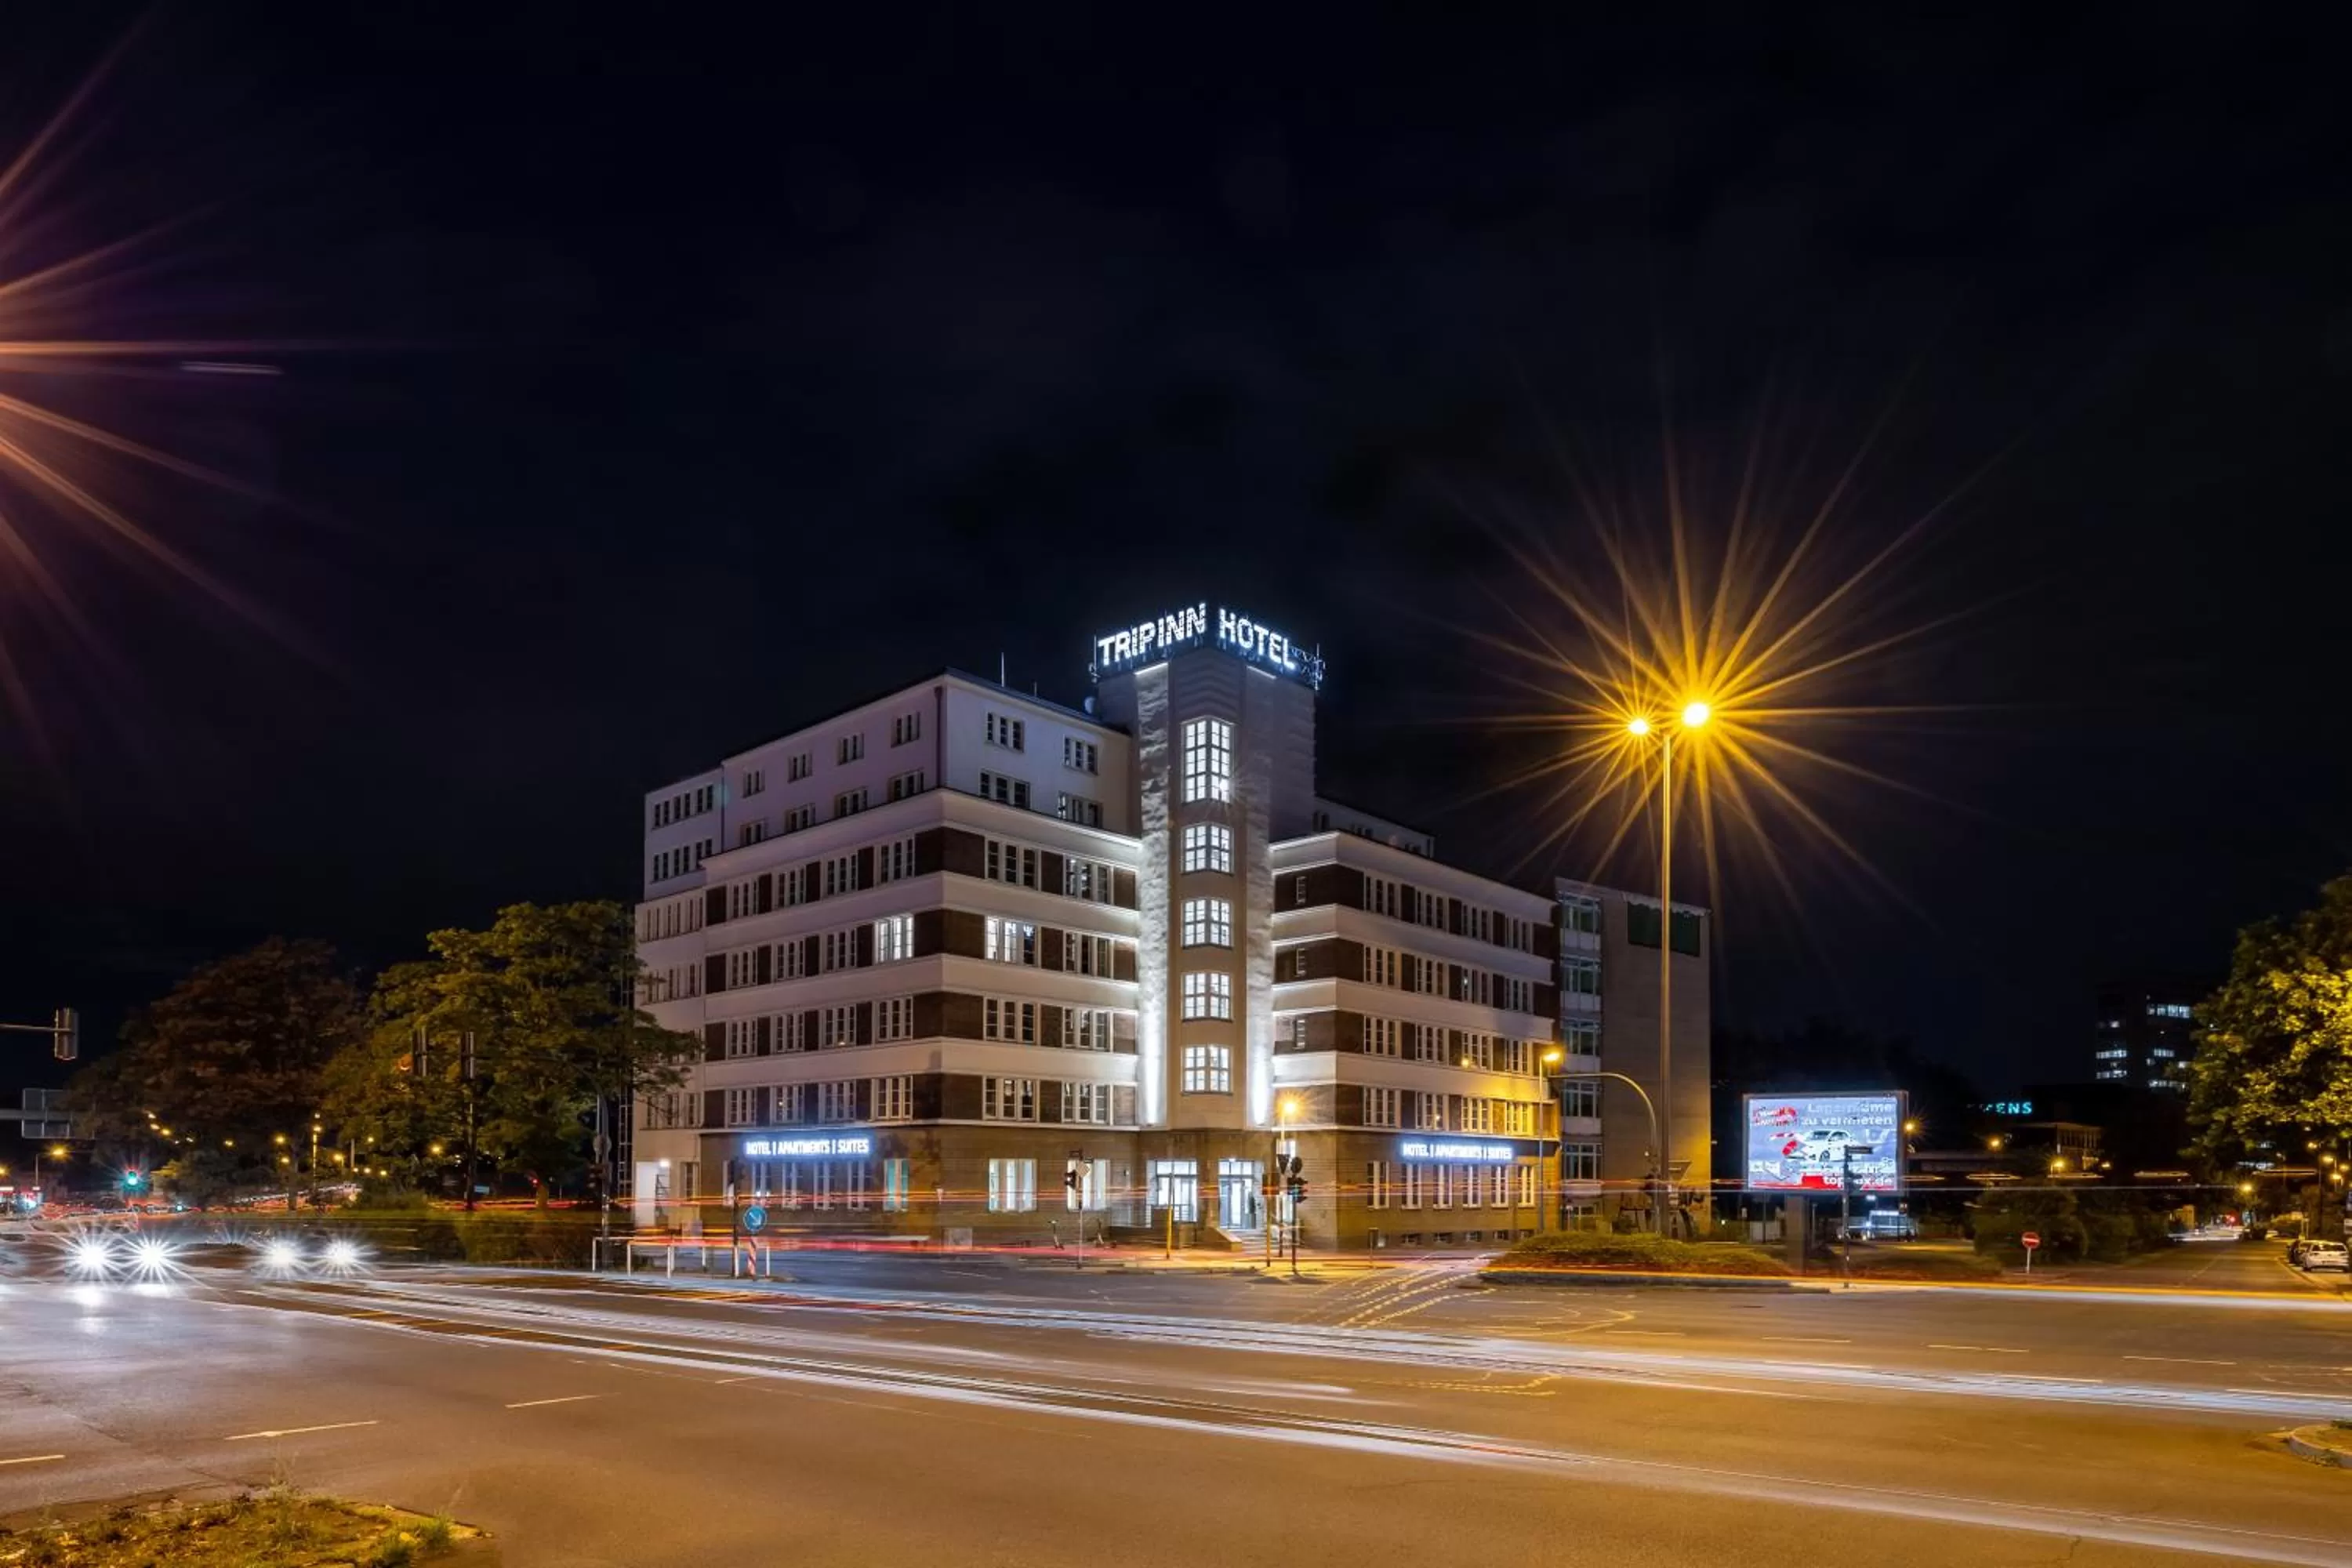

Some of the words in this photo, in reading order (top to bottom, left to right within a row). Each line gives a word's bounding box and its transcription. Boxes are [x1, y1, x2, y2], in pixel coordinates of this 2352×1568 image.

[1219, 608, 1296, 670] HOTEL
[746, 1142, 771, 1155] HOTEL
[777, 1140, 830, 1155] APARTMENTS
[837, 1138, 869, 1154] SUITES
[1403, 1143, 1428, 1157] HOTEL
